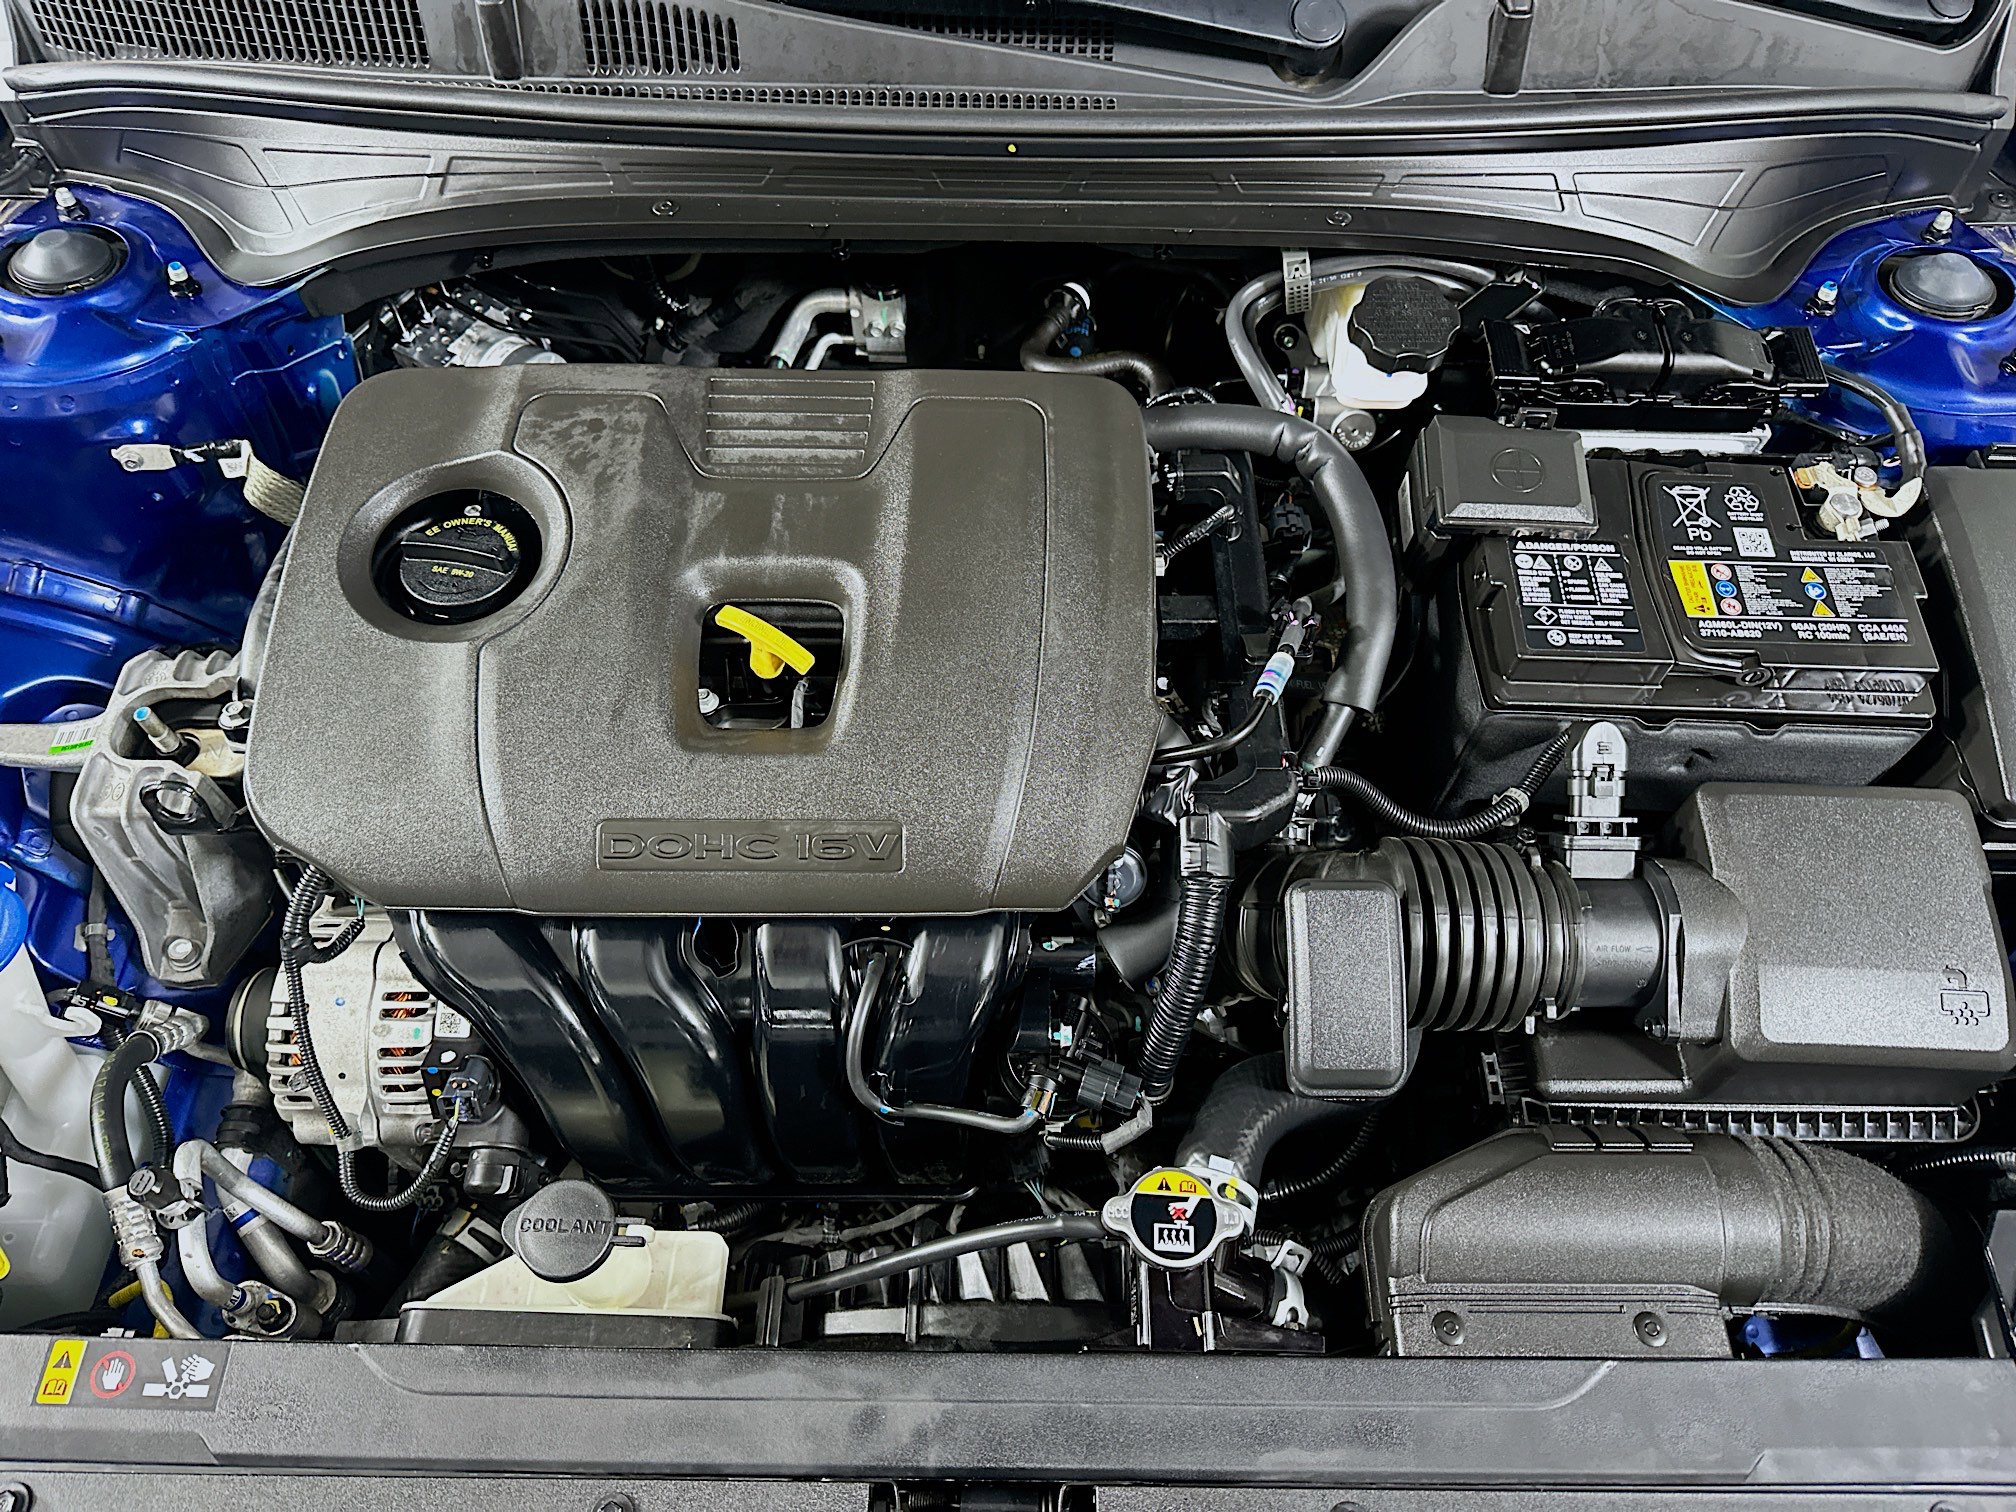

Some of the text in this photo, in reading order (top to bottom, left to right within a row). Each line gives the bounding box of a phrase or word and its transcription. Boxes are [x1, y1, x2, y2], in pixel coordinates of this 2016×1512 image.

[425, 526, 441, 537] EE
[443, 517, 492, 529] OWNER'S
[1687, 527, 1712, 541] Pb
[1525, 542, 1616, 552] DANGER/POISON
[431, 565, 449, 574] SAE
[1818, 623, 1851, 633] (20HR)
[1858, 624, 1880, 632] CCA
[1798, 631, 1850, 640] RC 100min
[1863, 632, 1908, 642] (SAE/EN)
[602, 833, 899, 860] DOHC 16V
[1596, 944, 1632, 953] AIR FLOW
[520, 1218, 612, 1236] COOLANT
